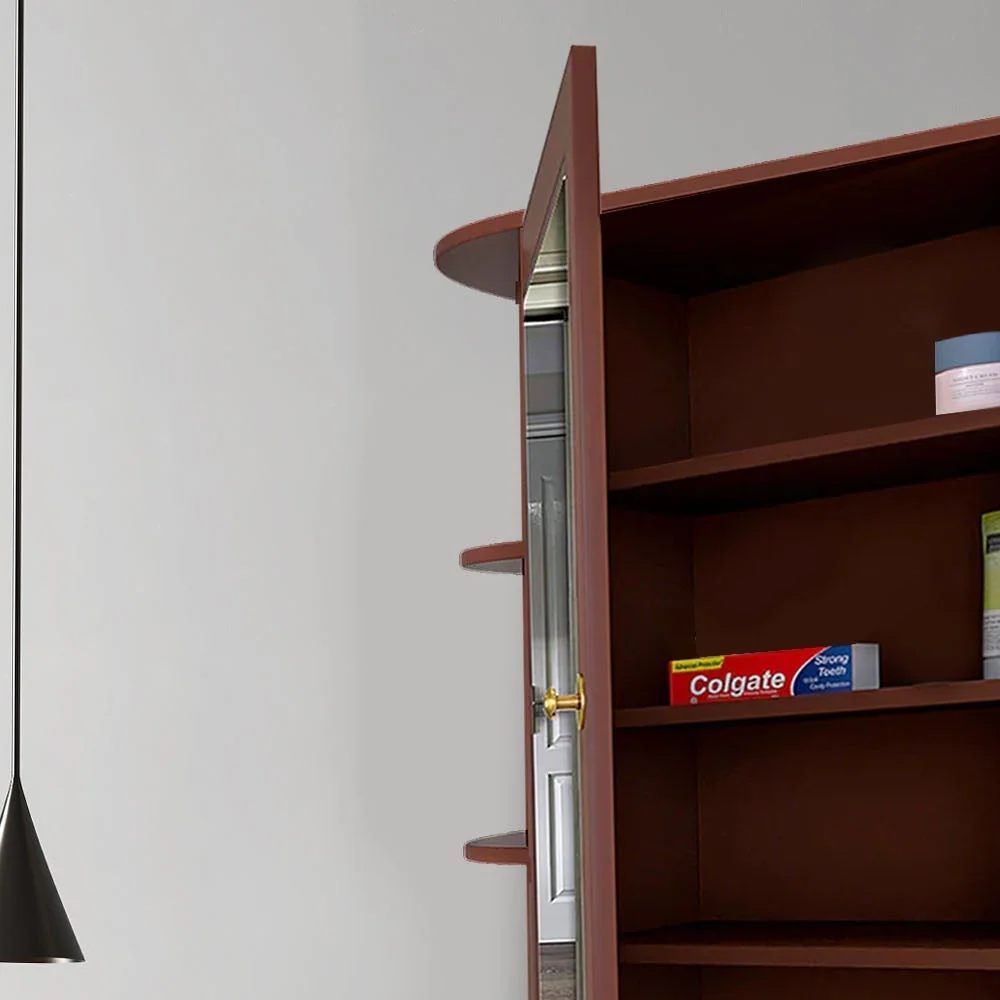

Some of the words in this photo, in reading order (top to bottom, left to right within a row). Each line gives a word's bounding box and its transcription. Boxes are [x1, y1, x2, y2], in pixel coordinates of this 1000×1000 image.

[814, 654, 849, 666] Strong
[818, 665, 847, 677] Teeth
[690, 669, 786, 698] Colgate
